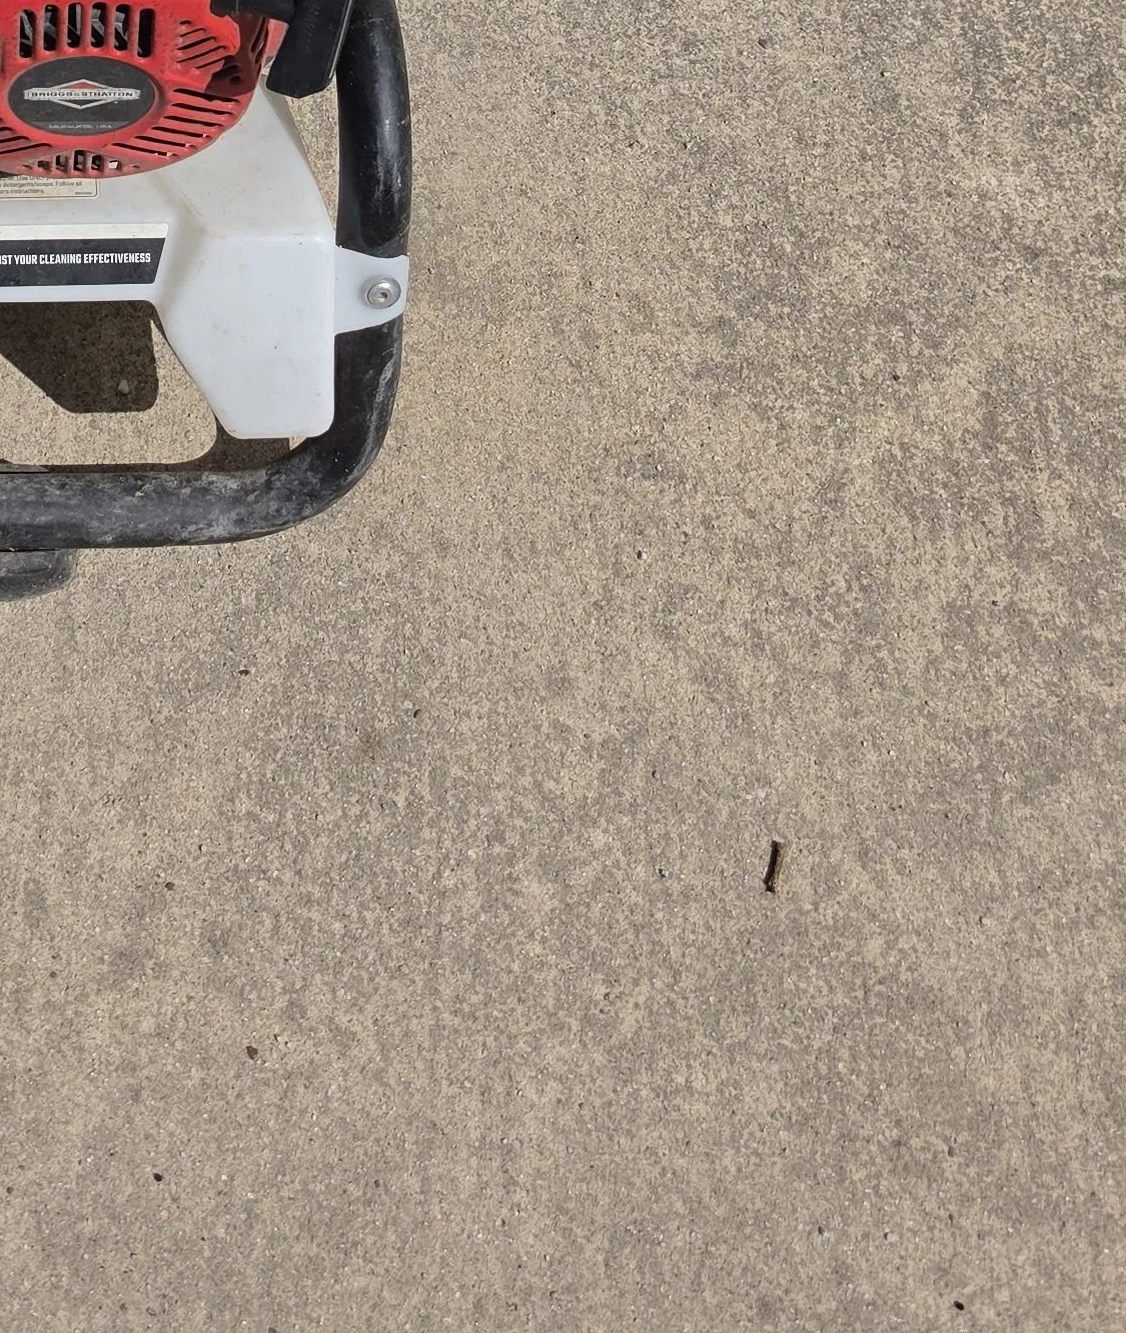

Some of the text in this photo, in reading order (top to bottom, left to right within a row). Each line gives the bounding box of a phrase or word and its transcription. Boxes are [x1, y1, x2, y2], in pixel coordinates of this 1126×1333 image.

[14, 254, 37, 265] YOUR
[39, 253, 81, 265] CLEANING
[83, 252, 151, 264] EFFECTIVENESS
